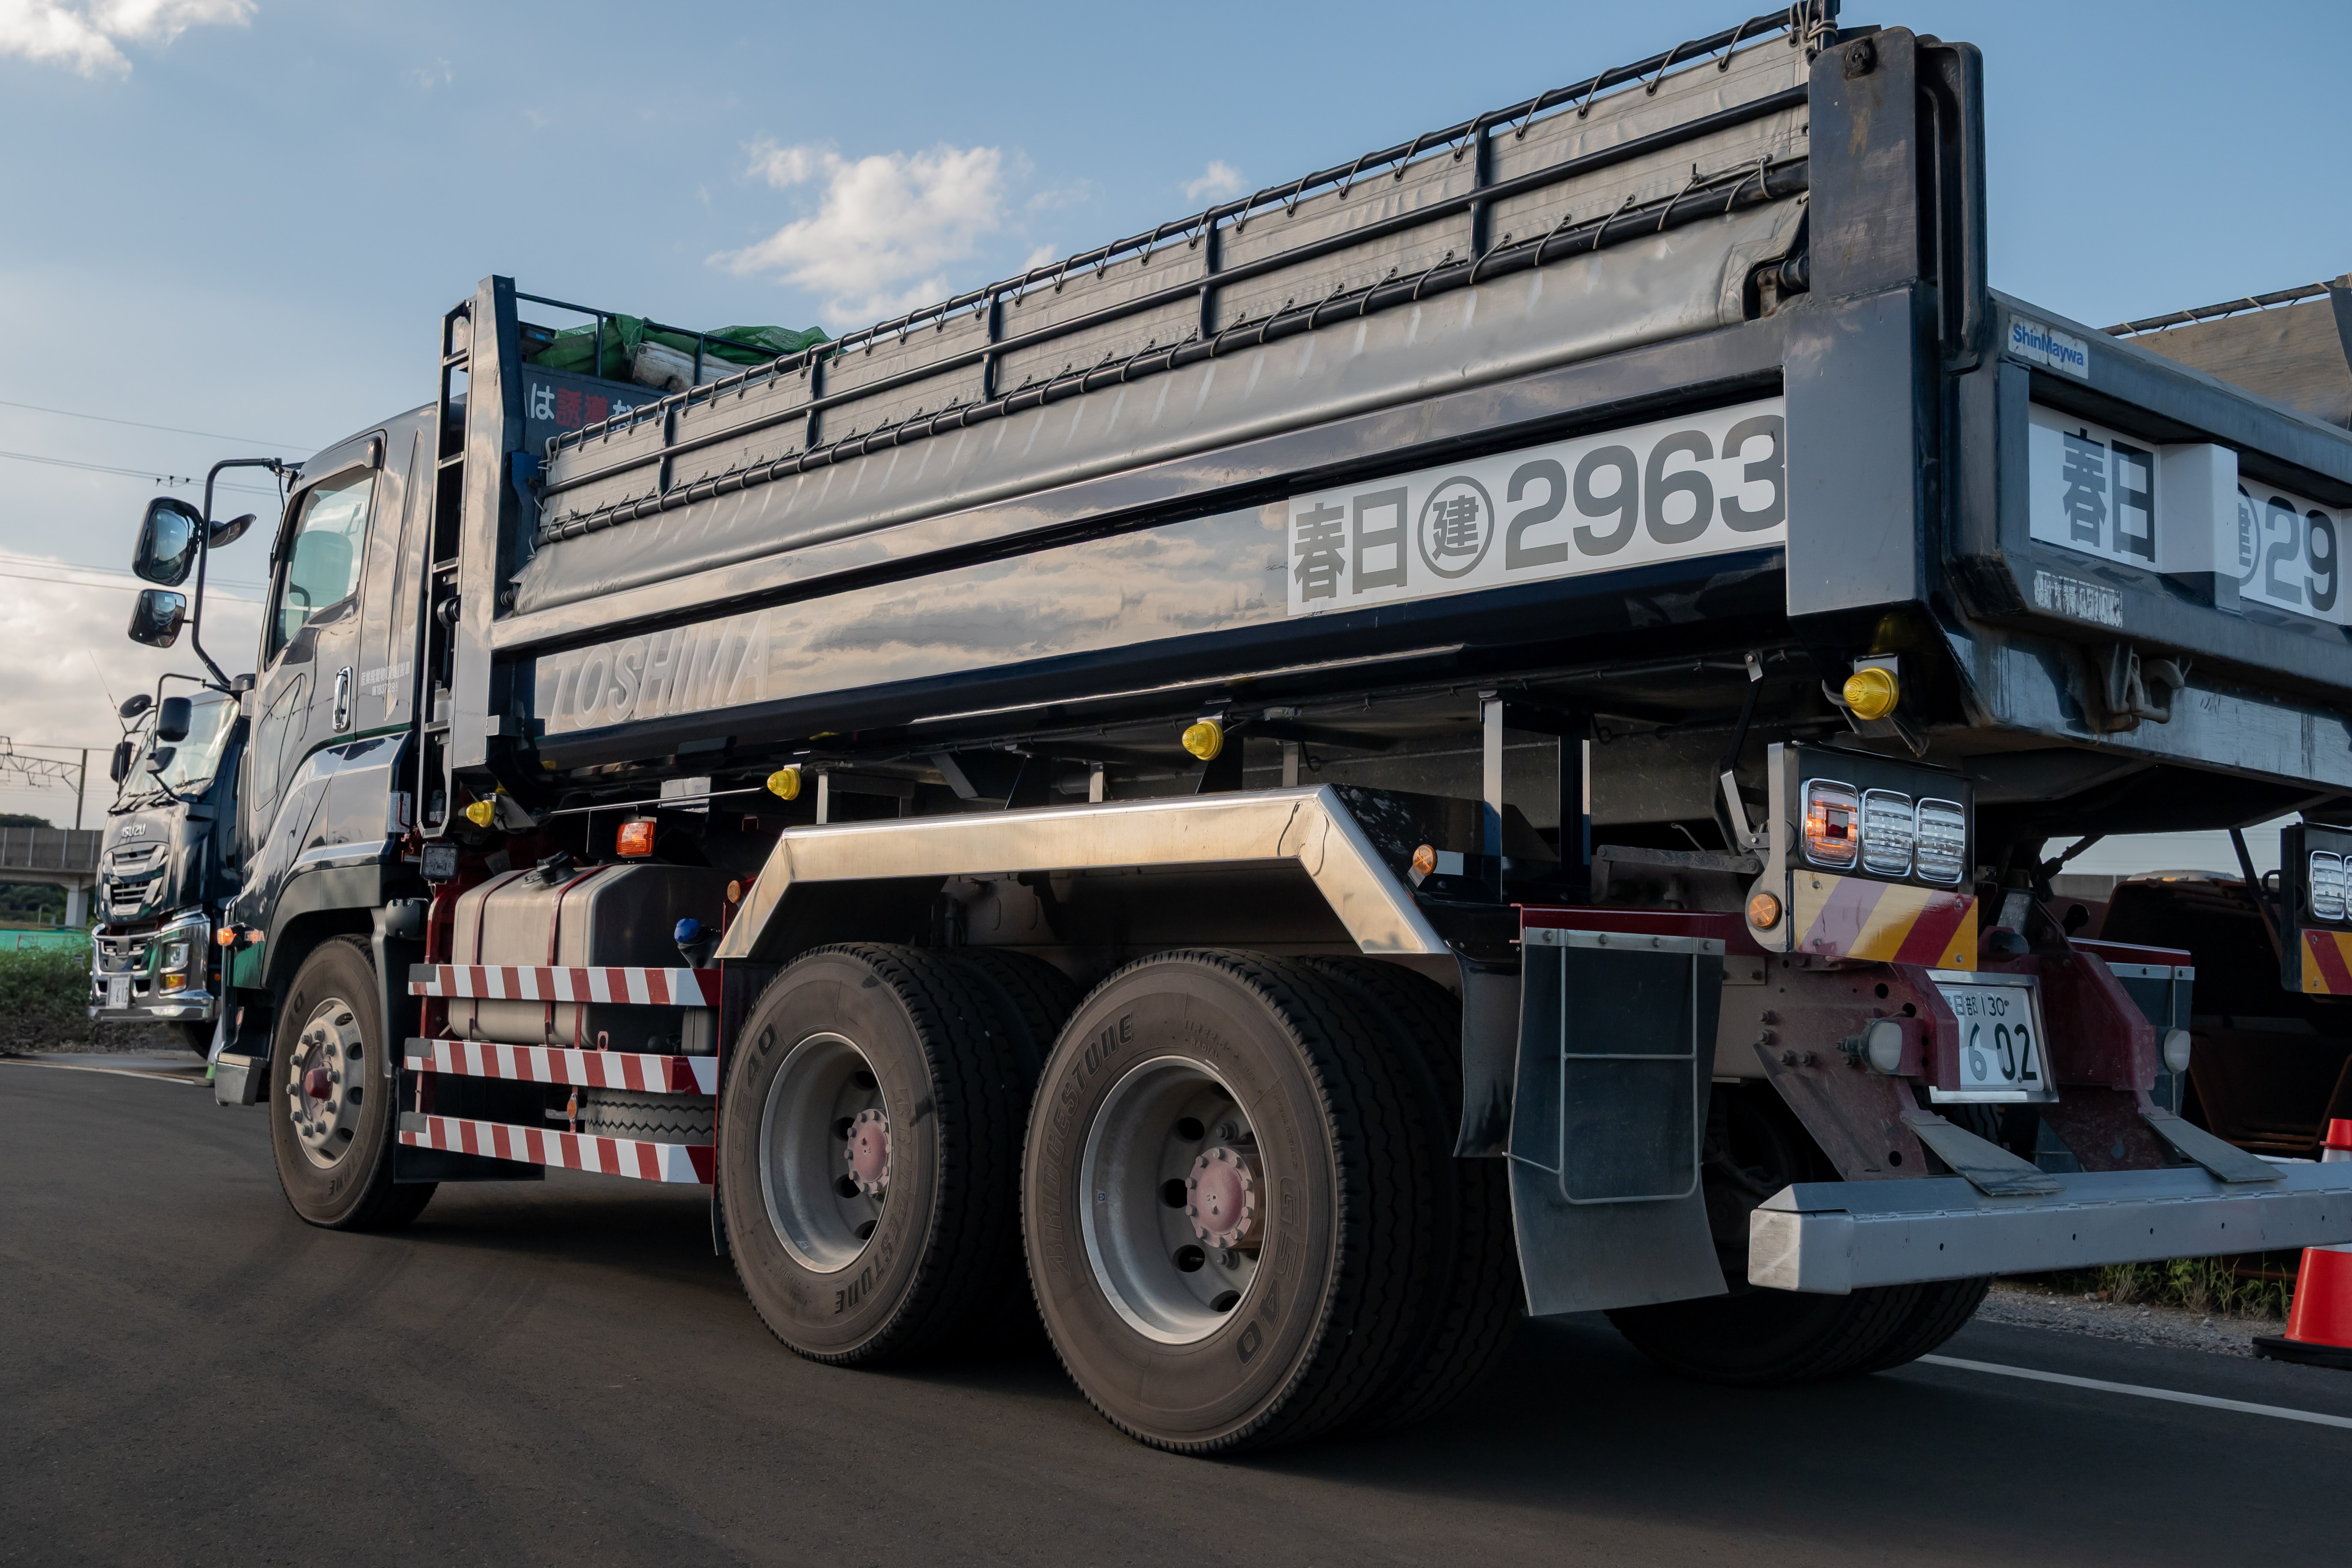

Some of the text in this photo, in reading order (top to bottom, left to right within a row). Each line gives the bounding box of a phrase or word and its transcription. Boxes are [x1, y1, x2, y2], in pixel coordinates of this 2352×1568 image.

[2013, 323, 2084, 366] ShinMaywa
[1293, 486, 1408, 603] 春日
[1506, 414, 1785, 570] 2963
[2062, 427, 2155, 563] 春日
[548, 608, 772, 733] TOSHIMA
[122, 823, 146, 837] ISUZU
[732, 1022, 777, 1166] G540
[1191, 1039, 1219, 1060] RADIAL
[834, 1088, 913, 1315] BRIDGESTONE
[1042, 1011, 1133, 1277] BRIDGESTONE
[1236, 1177, 1300, 1366] G540
